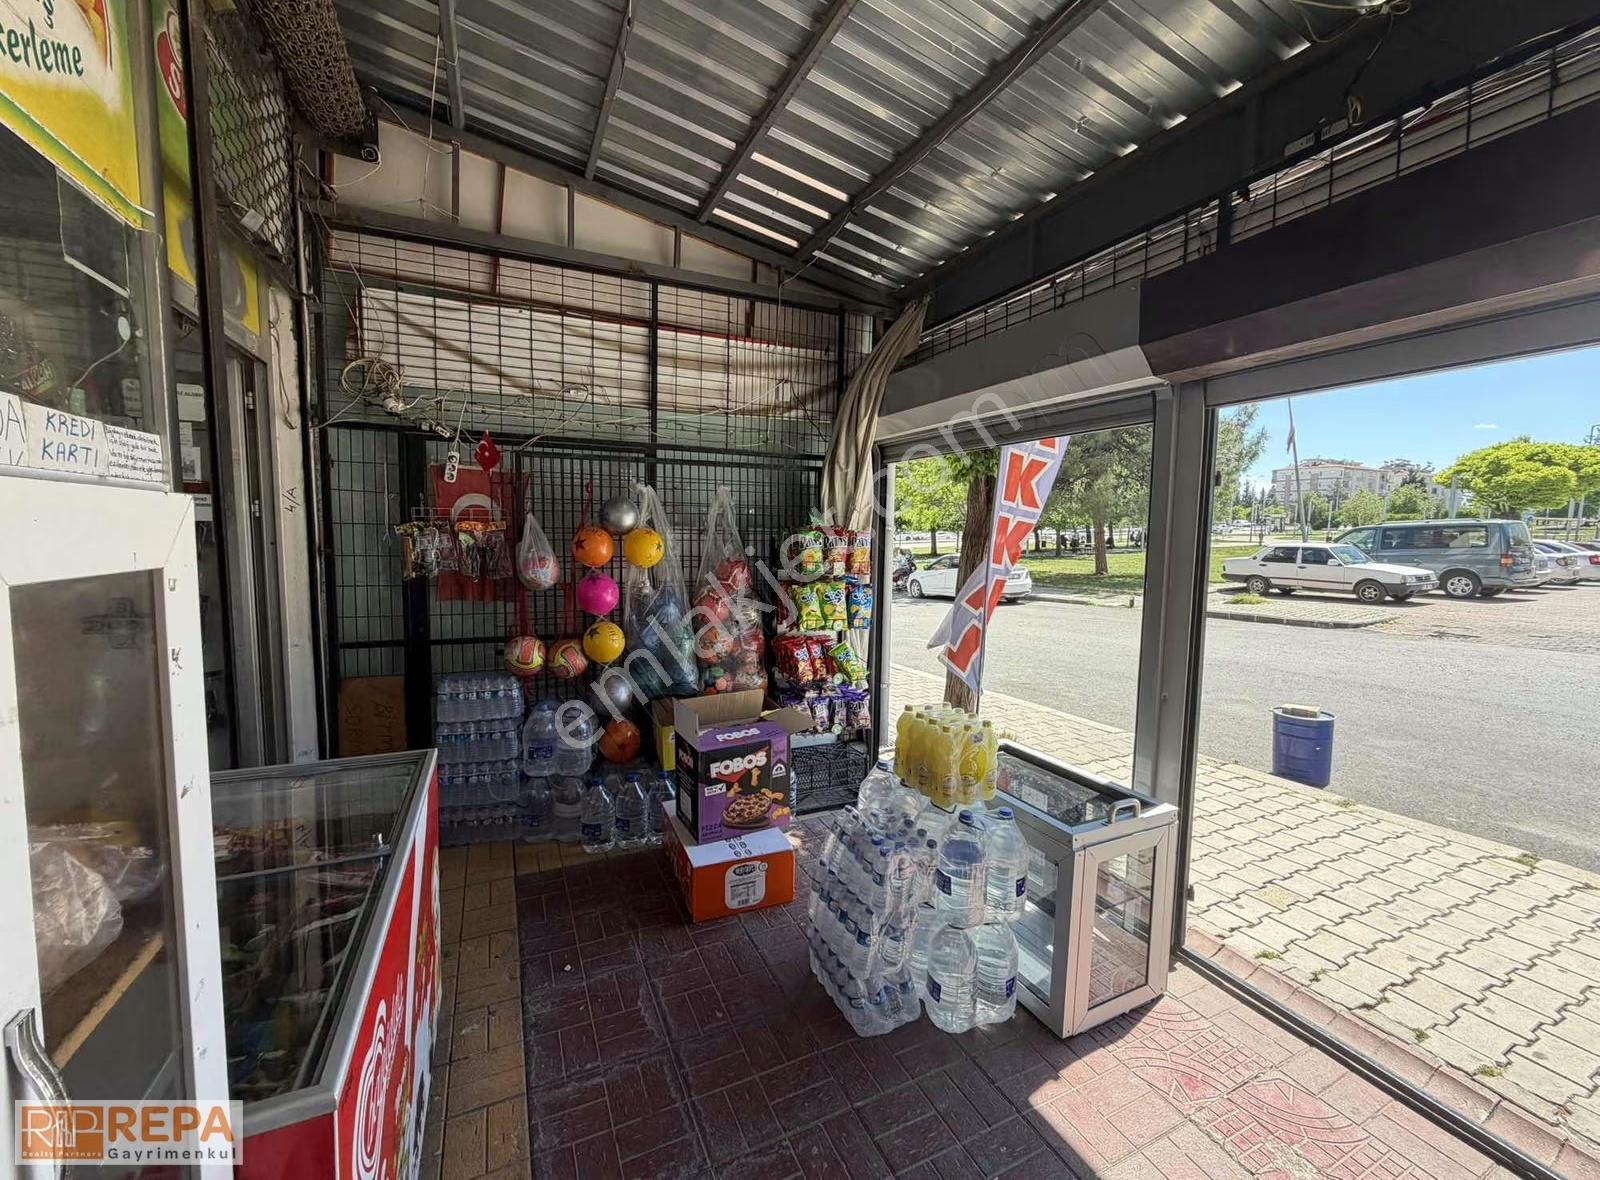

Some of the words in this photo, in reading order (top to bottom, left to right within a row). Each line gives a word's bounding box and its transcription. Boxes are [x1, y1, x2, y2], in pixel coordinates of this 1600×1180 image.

[41, 438, 99, 468] KARTI
[715, 727, 761, 743] FOBOS
[709, 751, 768, 779] FOBOS
